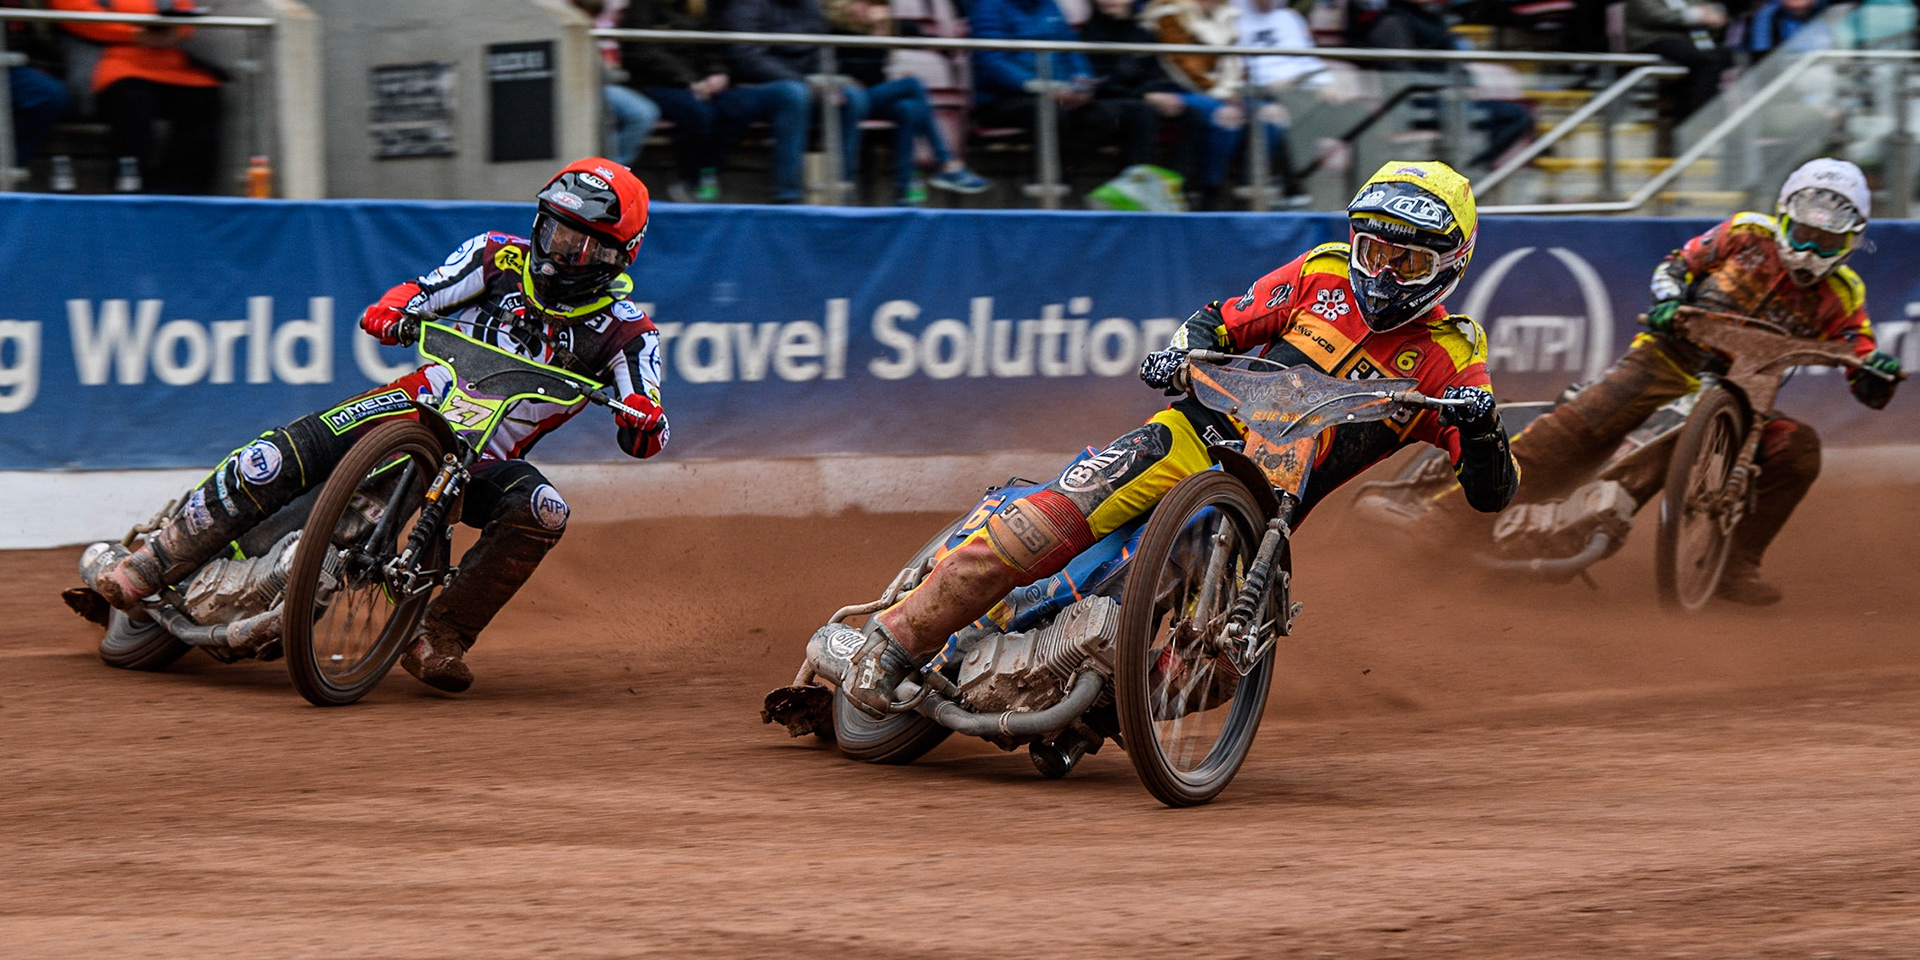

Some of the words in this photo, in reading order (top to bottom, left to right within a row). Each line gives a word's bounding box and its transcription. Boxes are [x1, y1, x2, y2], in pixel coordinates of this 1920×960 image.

[65, 296, 335, 385] World
[868, 297, 1180, 379] Solution
[1290, 323, 1313, 337] ONG
[1312, 336, 1336, 354] JCB
[1488, 315, 1585, 373] ATPI
[1396, 350, 1419, 371] 6
[249, 447, 270, 477] ATPI
[540, 496, 567, 516] ATPI
[961, 498, 1001, 531] 6
[1000, 505, 1050, 554] JCB
